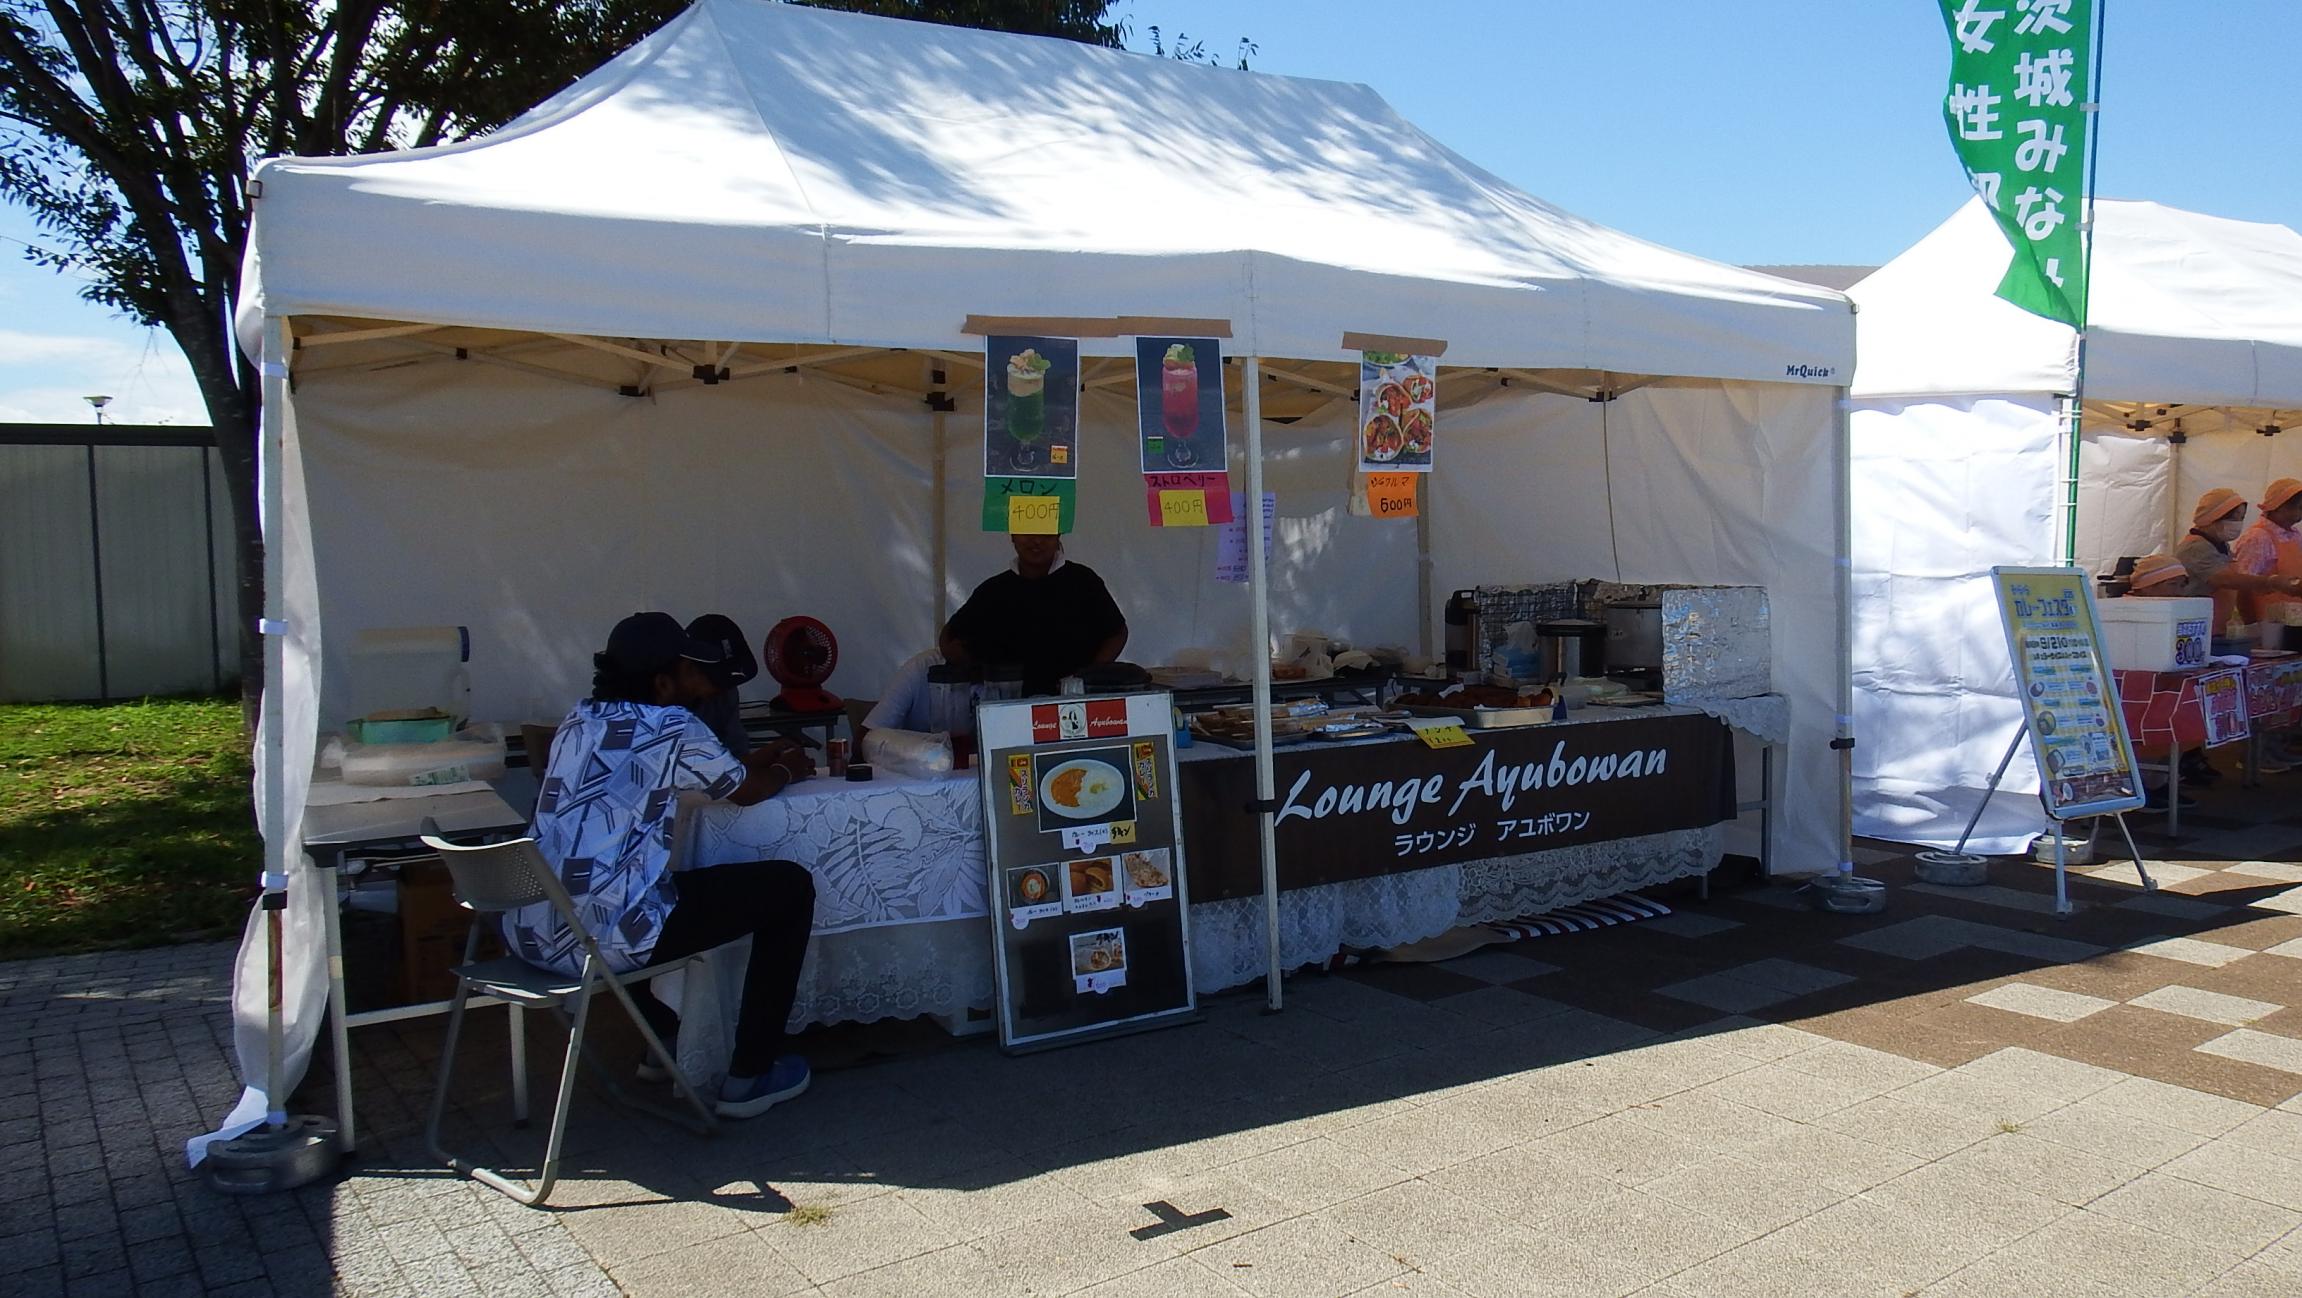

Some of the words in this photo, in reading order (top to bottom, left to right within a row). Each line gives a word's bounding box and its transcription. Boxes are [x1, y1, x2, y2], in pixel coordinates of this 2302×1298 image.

[1001, 480, 1057, 495] メロン
[1164, 499, 1203, 514] 400円
[1275, 769, 1443, 827] Lounge
[1448, 740, 1667, 816] Ayubowan
[1395, 823, 1476, 856] ラウンジ
[1497, 812, 1590, 841] アユボワン
